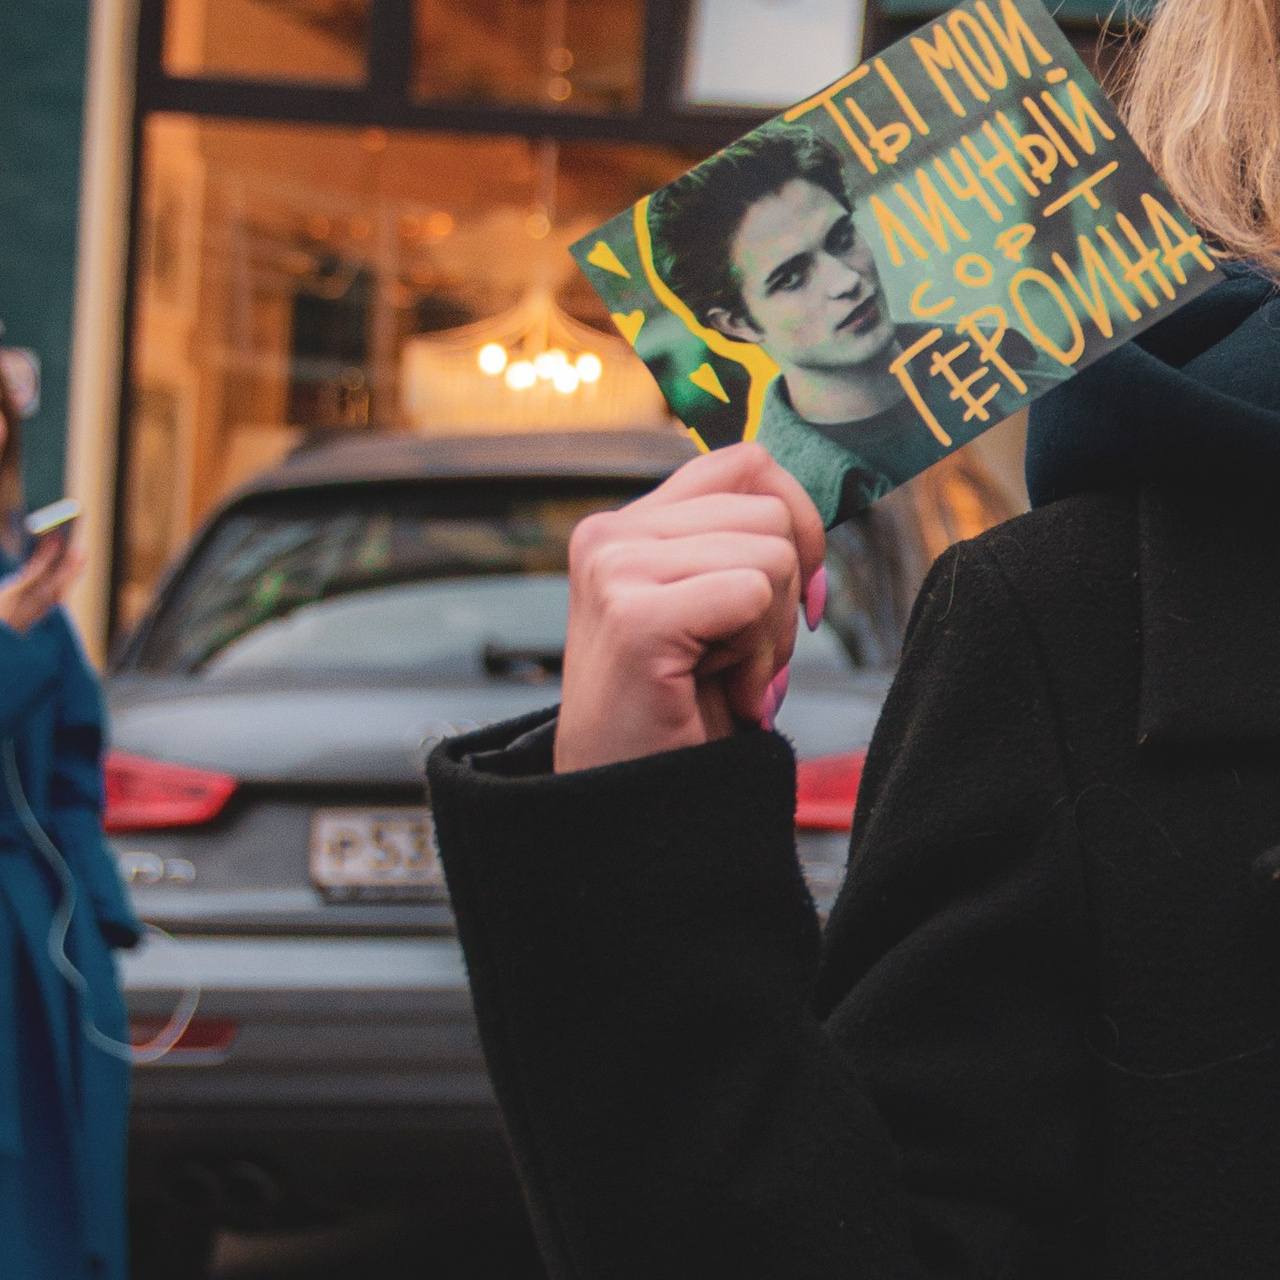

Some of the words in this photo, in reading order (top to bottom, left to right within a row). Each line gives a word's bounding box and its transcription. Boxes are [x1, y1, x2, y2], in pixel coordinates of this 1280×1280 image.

[783, 58, 930, 174] ТЫ
[869, 67, 1116, 266] ЛИЧНЫЙ
[888, 192, 1215, 447] ГЕРОИНА
[909, 160, 1119, 318] СОРТ
